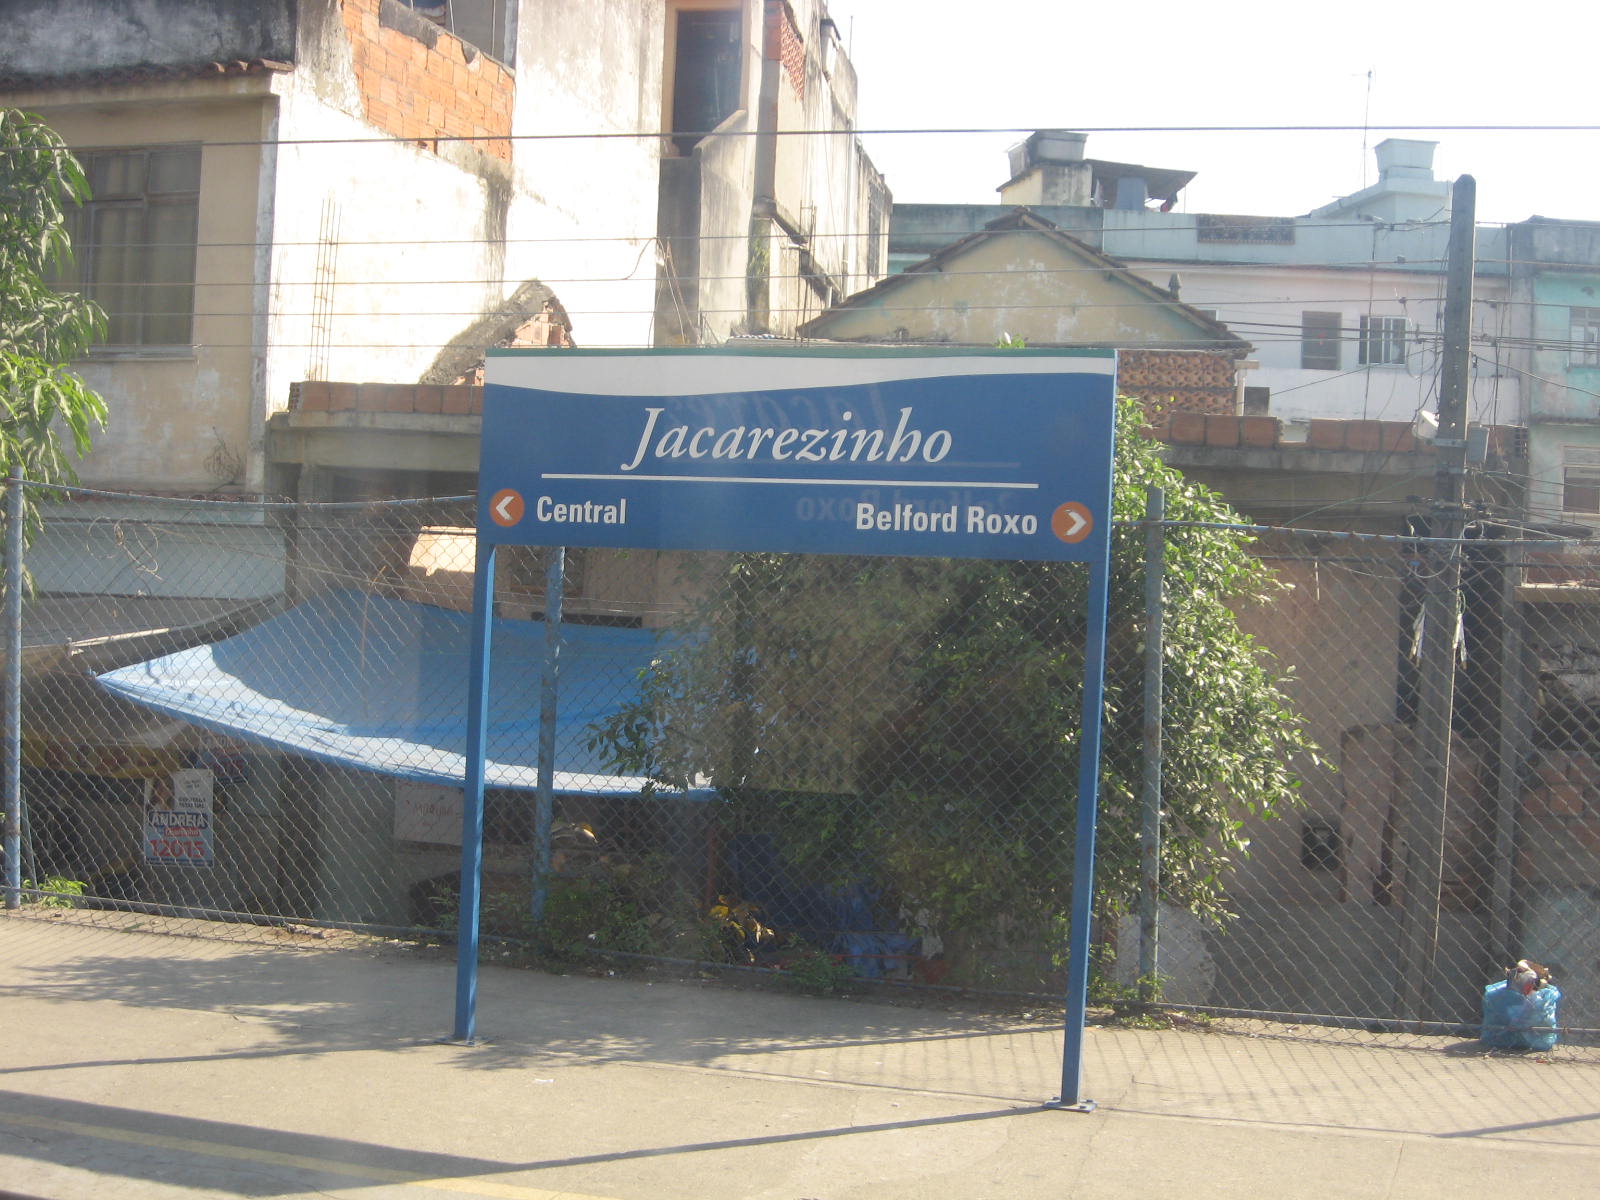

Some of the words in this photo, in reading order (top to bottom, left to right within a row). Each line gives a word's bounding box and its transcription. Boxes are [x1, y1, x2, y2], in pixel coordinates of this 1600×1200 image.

[621, 407, 952, 471] Jacarezinho
[536, 496, 627, 525] Central
[856, 503, 957, 533] Belford
[967, 506, 1037, 534] Roxo
[151, 813, 205, 828] ANDREIA
[150, 840, 206, 858] 12015
